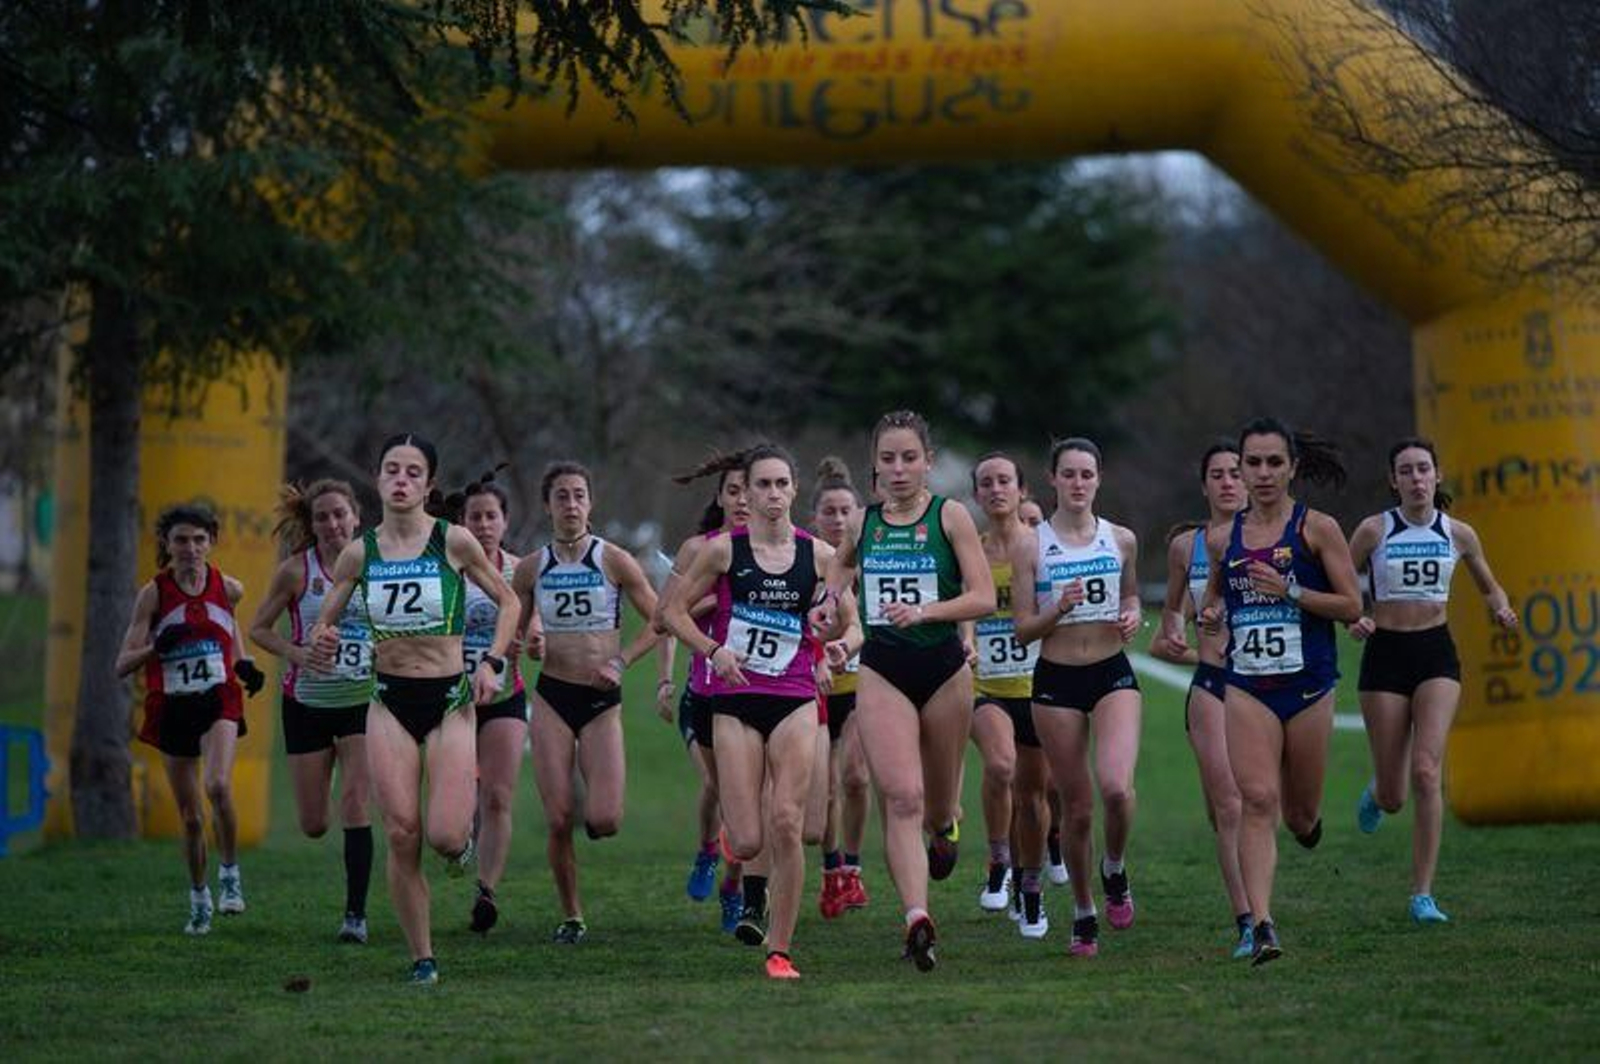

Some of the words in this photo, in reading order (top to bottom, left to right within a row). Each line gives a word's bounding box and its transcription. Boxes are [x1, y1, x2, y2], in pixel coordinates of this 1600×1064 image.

[424, 560, 439, 574] 22
[1403, 560, 1440, 586] 59
[383, 582, 424, 616] 72
[555, 591, 592, 618] 25
[748, 590, 758, 601] O
[760, 590, 800, 601] BARCO
[879, 577, 921, 605] 55
[746, 627, 781, 659] 15
[989, 636, 1028, 664] 35
[1243, 627, 1286, 659] 45
[177, 659, 212, 685] 14
